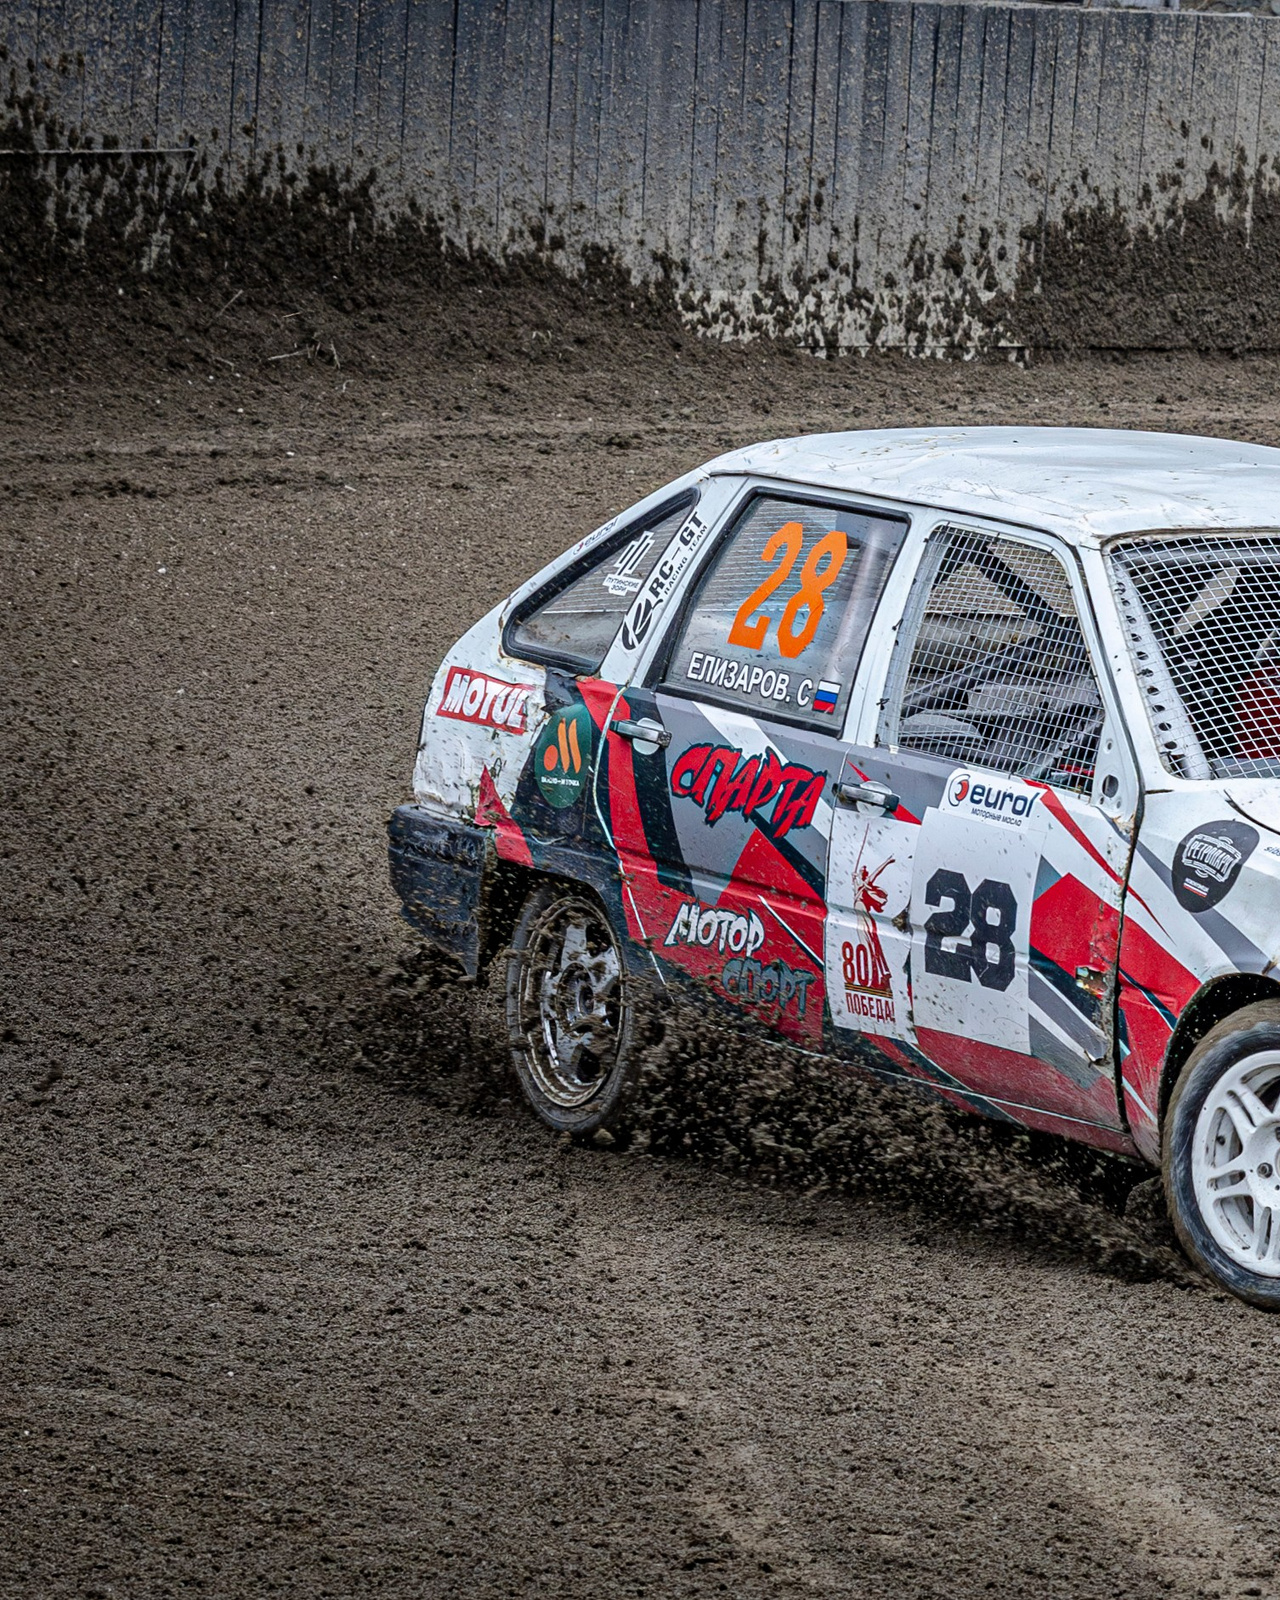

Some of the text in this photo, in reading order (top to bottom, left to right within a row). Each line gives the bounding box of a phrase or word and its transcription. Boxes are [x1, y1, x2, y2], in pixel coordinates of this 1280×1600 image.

[664, 525, 708, 595] RACING TEAM
[726, 521, 848, 660] 28
[441, 673, 530, 729] MOTUL
[686, 651, 792, 703] ЕЛИЗАРОВ.
[670, 743, 828, 840] СПАРТА
[969, 783, 1040, 818] eurol
[1187, 840, 1235, 875] РЕТРОПАРК
[663, 902, 765, 957] МОТОР
[924, 868, 1018, 992] 28
[842, 941, 869, 988] 80
[845, 992, 896, 1024] ПОБЕДА!
